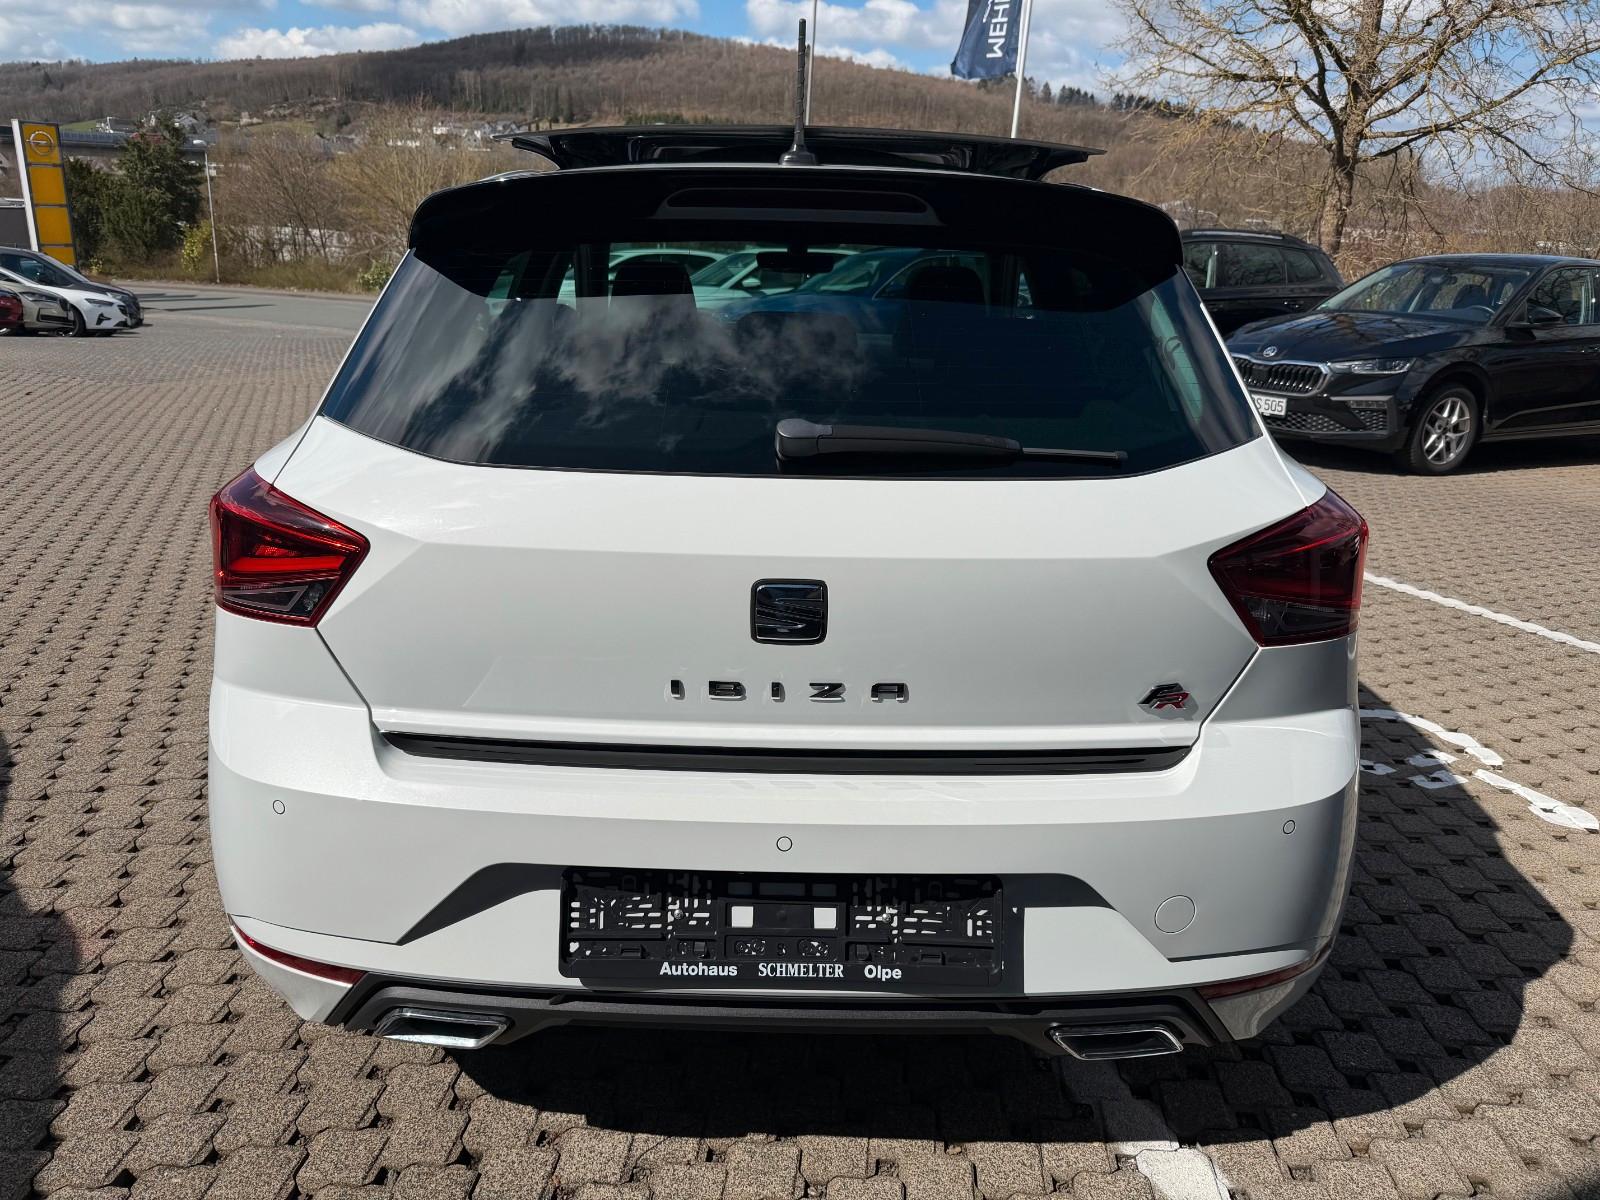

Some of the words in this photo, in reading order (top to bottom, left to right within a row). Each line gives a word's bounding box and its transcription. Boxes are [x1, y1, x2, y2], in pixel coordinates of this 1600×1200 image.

[1264, 399, 1284, 413] 505
[670, 678, 907, 701] IBIZA
[659, 961, 738, 977] Autohaus
[758, 962, 845, 979] SCHMELTER
[863, 964, 903, 982] Olpe
